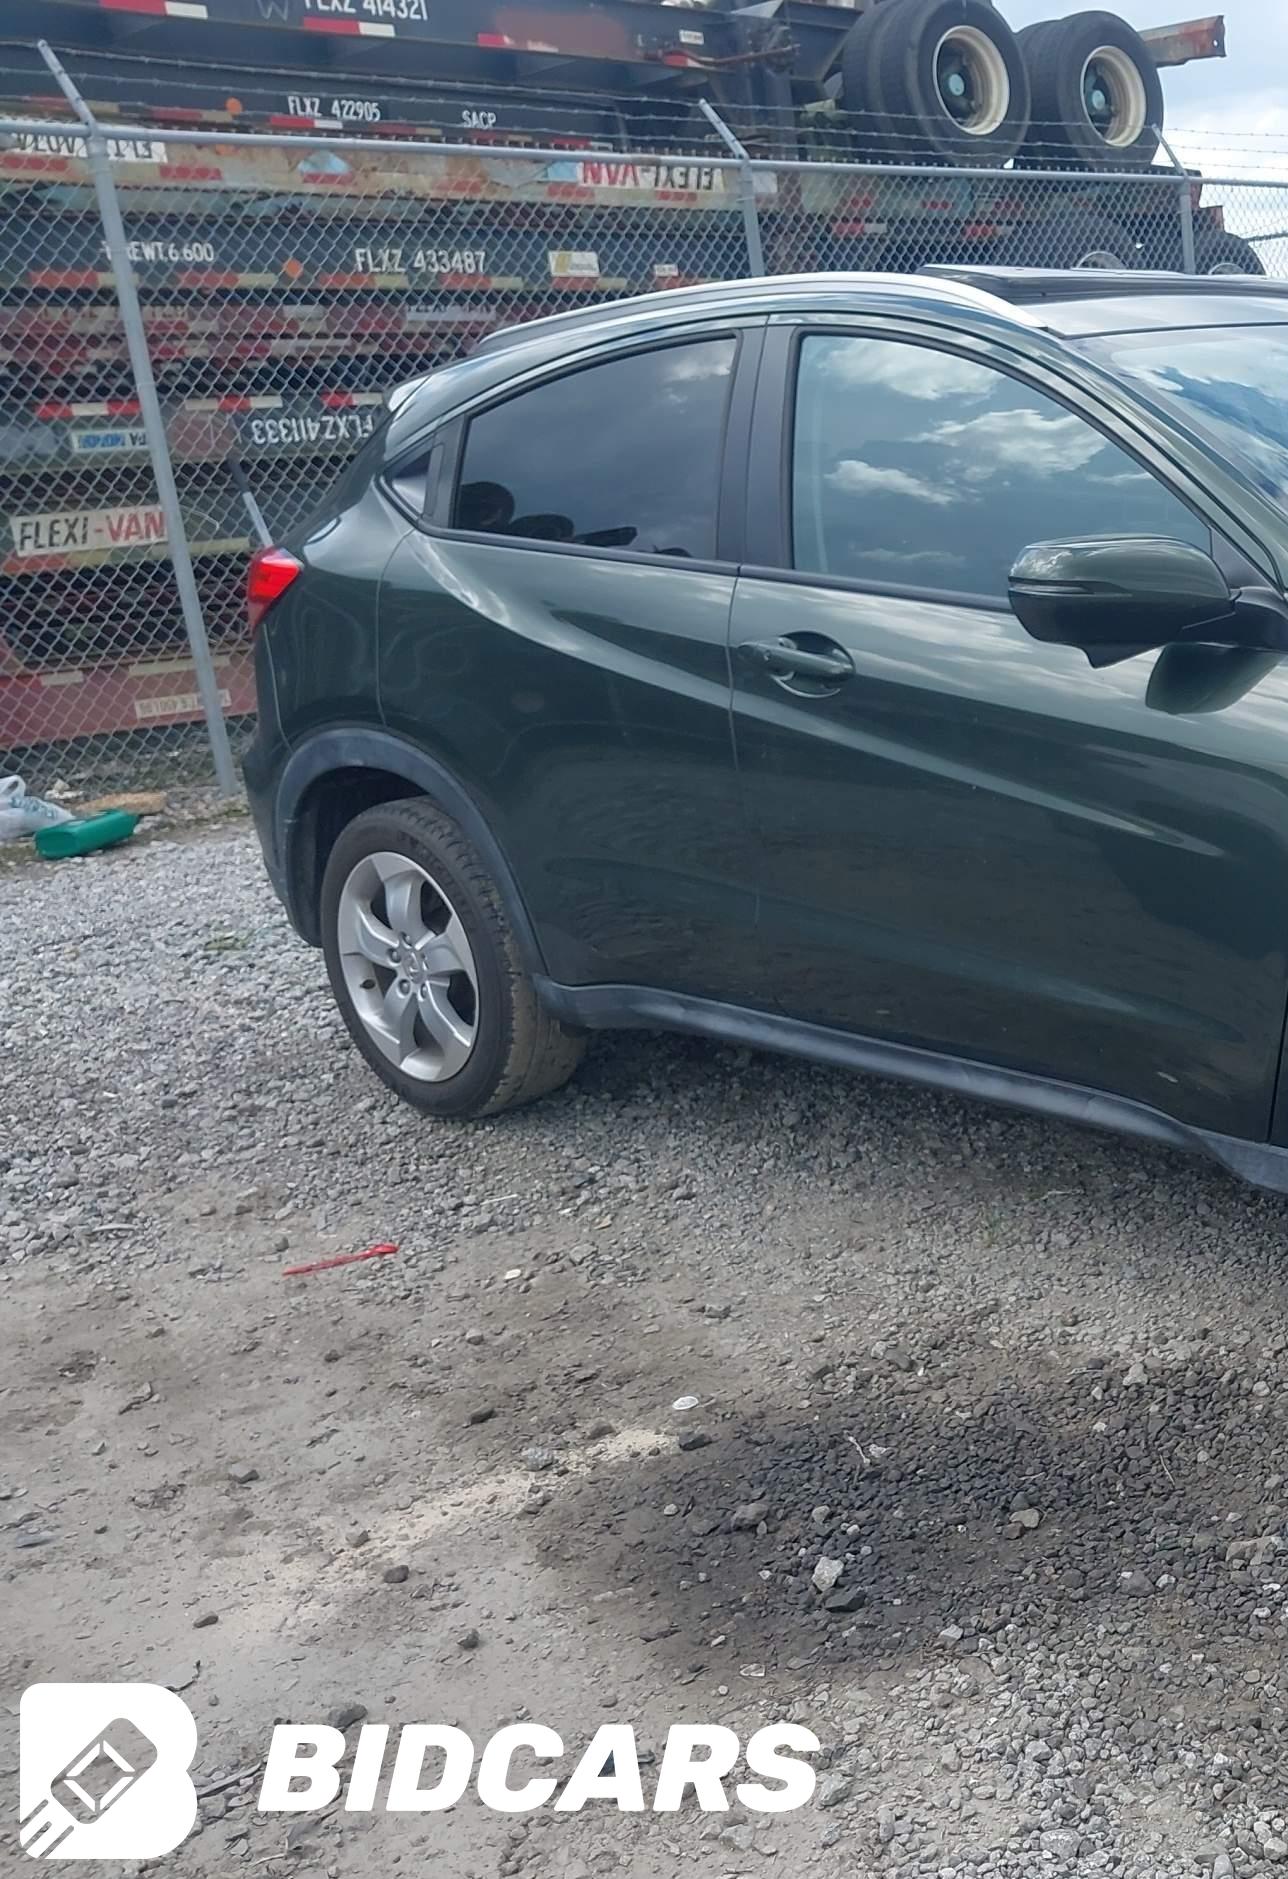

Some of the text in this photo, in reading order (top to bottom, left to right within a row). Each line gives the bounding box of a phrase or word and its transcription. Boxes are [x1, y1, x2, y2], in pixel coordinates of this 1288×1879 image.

[288, 96, 381, 122] FLXZ 422905
[462, 110, 496, 129] SACP
[355, 248, 486, 274] FLXZ 433487
